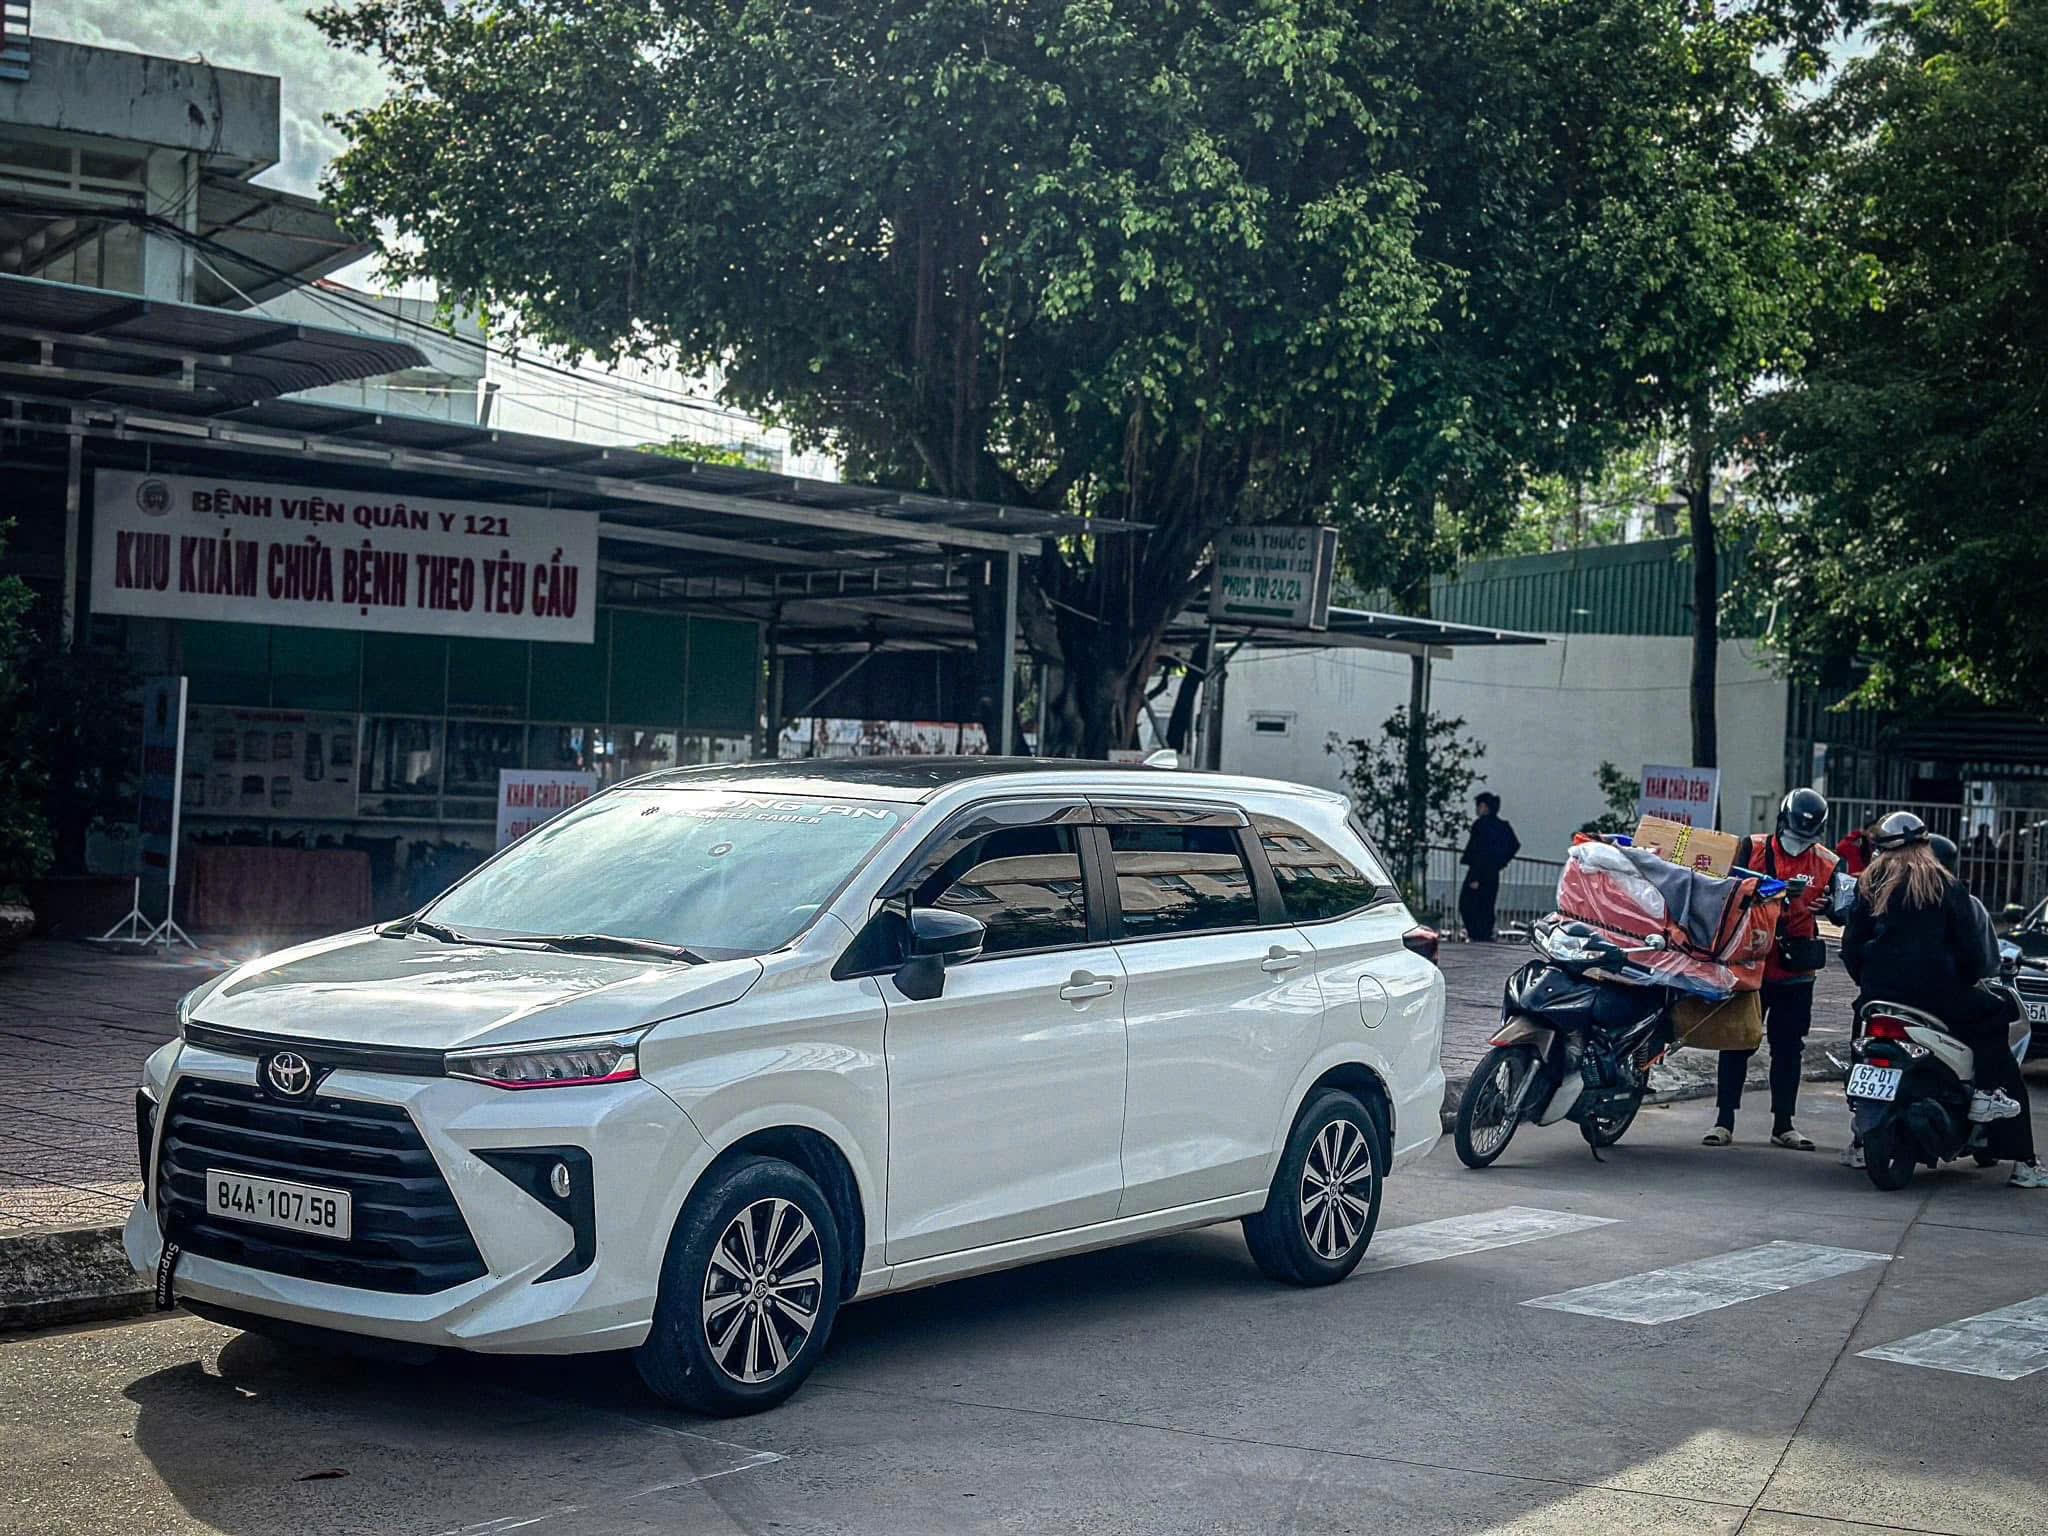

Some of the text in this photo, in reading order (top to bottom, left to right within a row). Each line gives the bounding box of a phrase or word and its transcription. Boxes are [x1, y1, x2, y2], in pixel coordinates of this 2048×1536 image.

[192, 488, 511, 537] BỆNH VIỆN QUÂN Y 121
[115, 530, 171, 592] KHU
[179, 528, 259, 597] KHÁM
[267, 534, 334, 602] CHỮA
[342, 538, 408, 616] BỆNH
[416, 553, 475, 612] THEO
[483, 549, 528, 615] YÊU
[818, 804, 889, 820] AN
[1850, 1081, 1894, 1098] 259.72
[218, 1181, 337, 1228] 84A-107.58
[158, 1242, 179, 1305] Supreme
